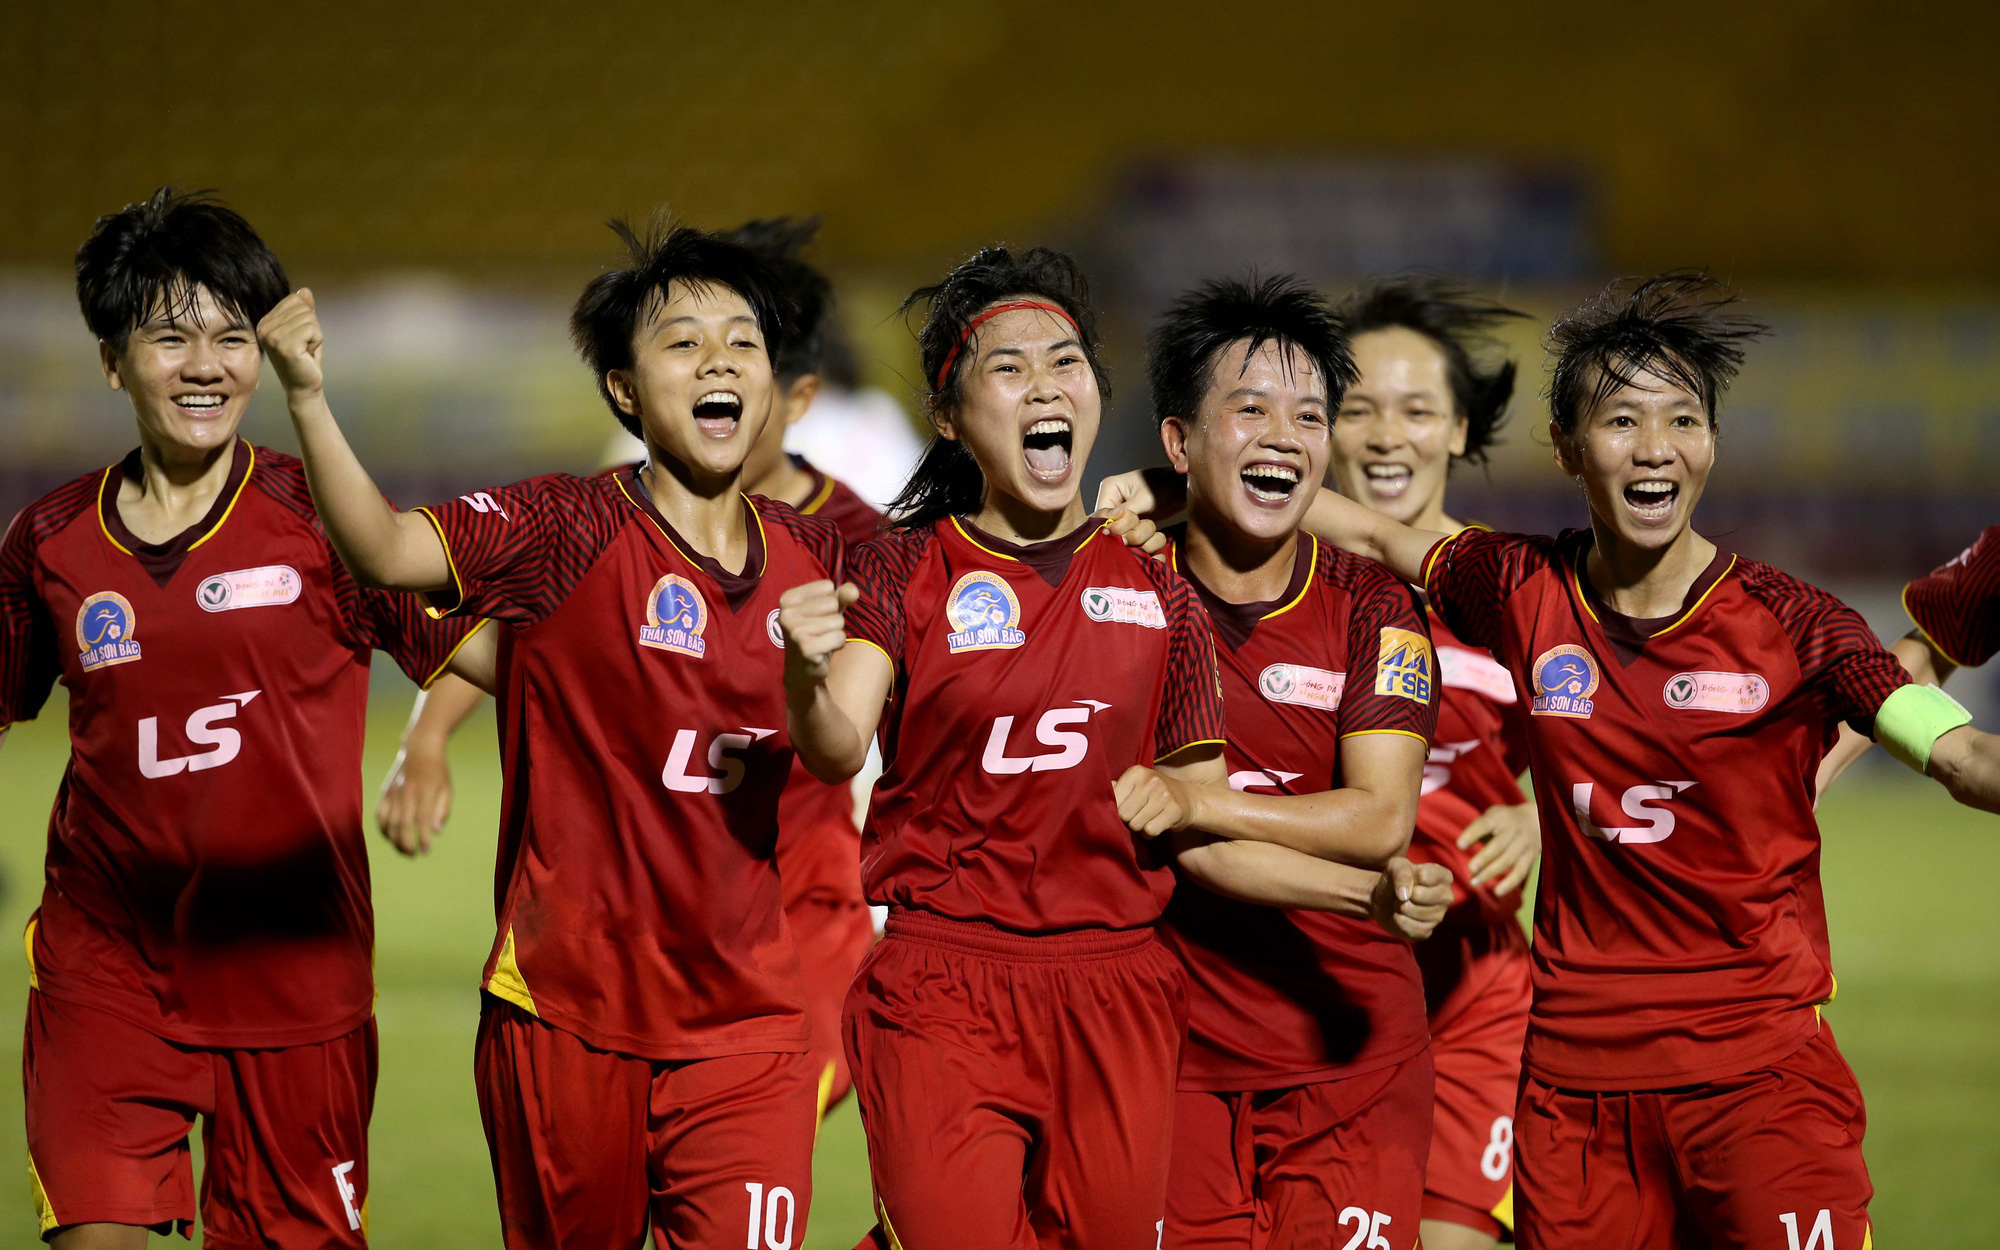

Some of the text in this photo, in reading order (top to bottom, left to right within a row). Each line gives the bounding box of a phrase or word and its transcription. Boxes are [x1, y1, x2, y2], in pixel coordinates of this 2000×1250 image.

[82, 648, 99, 667] THÁI
[99, 643, 117, 660] SƠN
[642, 626, 664, 642] THÁI
[666, 629, 686, 646] SƠN
[951, 630, 975, 647] THÁI
[1001, 628, 1023, 643] BẮC
[1381, 668, 1430, 702] TSB
[1550, 695, 1571, 711] SƠN
[138, 702, 242, 779] LS
[662, 729, 751, 795] LS
[982, 707, 1090, 775] LS
[1573, 782, 1676, 843] LS
[1480, 1115, 1514, 1181] 8
[745, 1182, 795, 1250] 10
[1338, 1206, 1392, 1250] 25
[1779, 1209, 1834, 1250] 14
